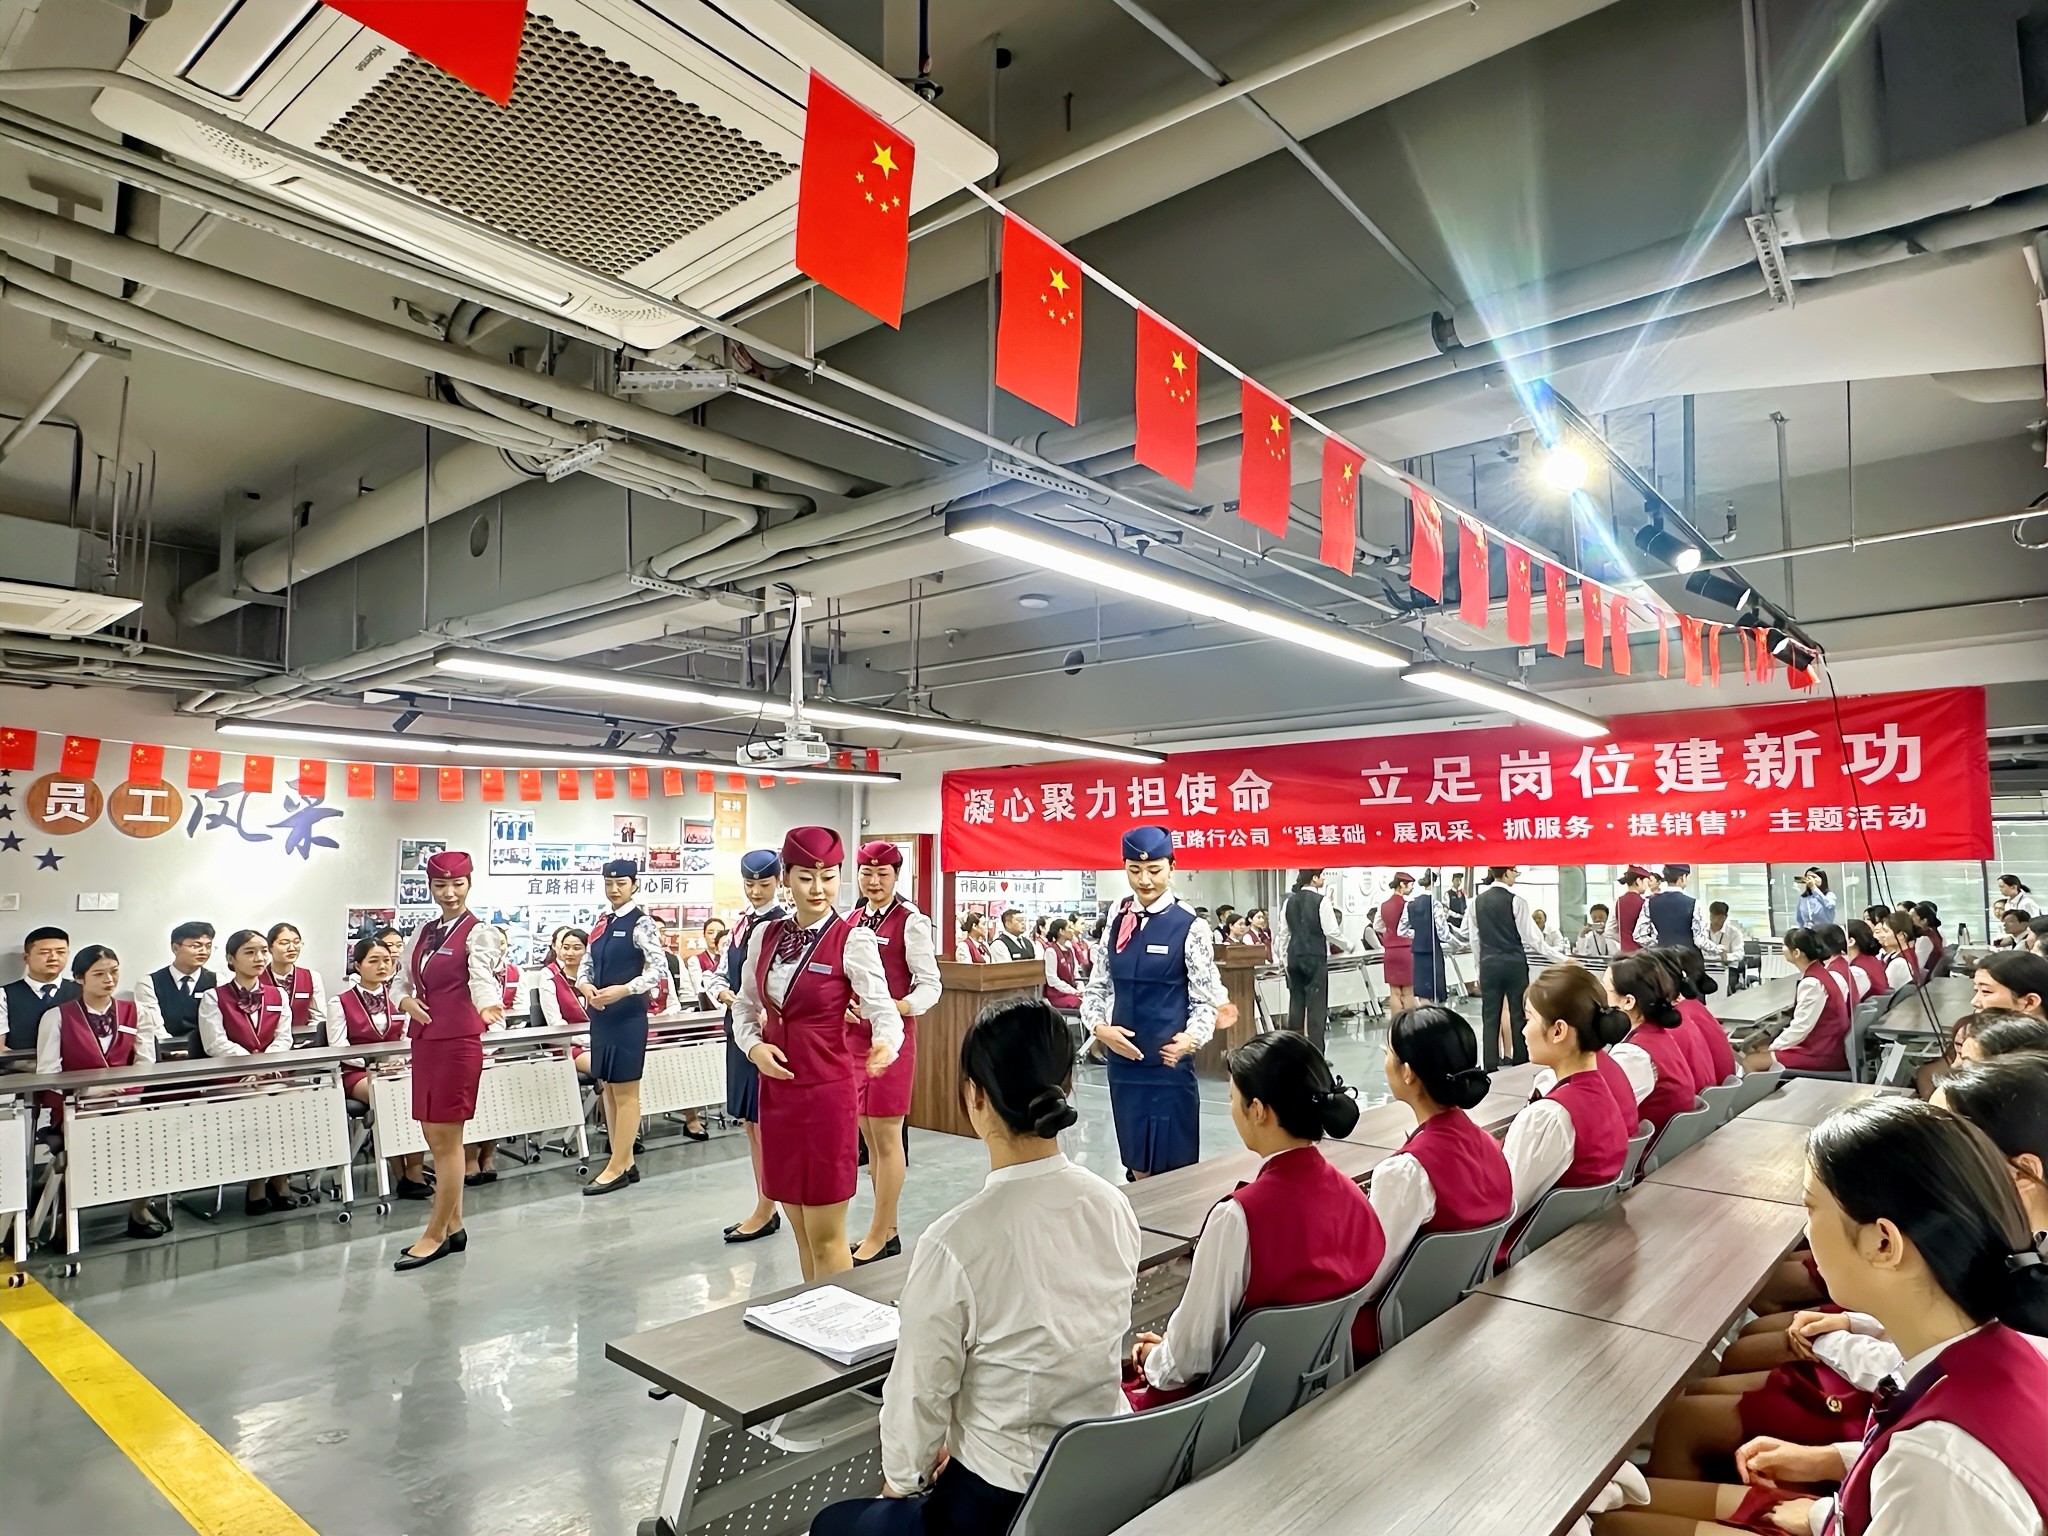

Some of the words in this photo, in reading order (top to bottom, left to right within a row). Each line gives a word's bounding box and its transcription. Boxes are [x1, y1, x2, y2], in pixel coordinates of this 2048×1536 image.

[963, 769, 1274, 825] 凝心聚力担使命
[1359, 723, 1922, 807] 立足岗位建新功
[1769, 803, 1927, 833] 主题活动
[528, 877, 596, 895] 宜路相伴
